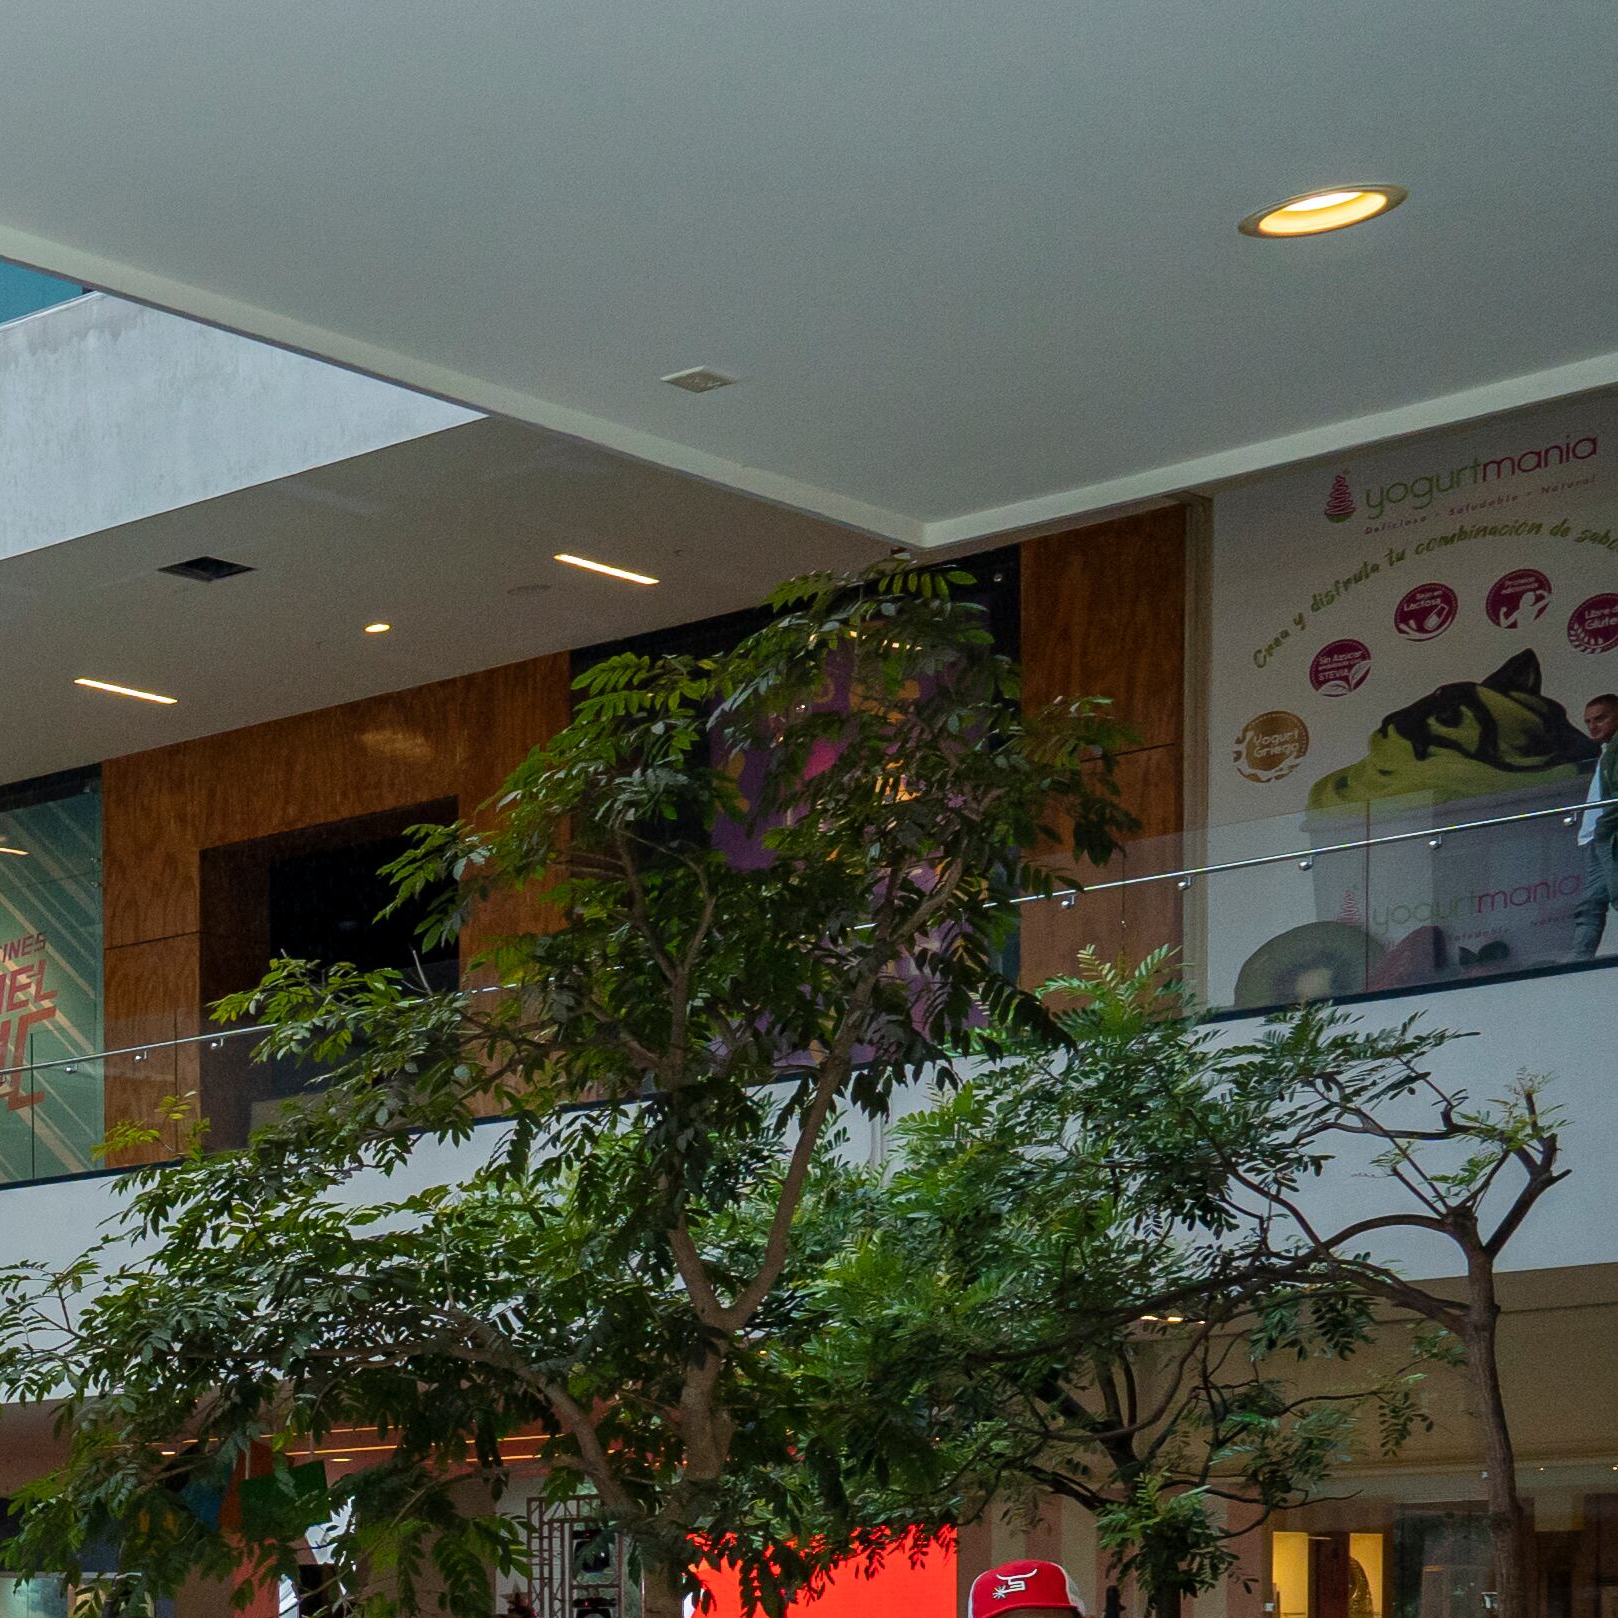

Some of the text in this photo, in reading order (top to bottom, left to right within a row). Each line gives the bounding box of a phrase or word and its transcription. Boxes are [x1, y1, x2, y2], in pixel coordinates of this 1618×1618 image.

[1365, 434, 1598, 519] yogurtmania
[1384, 548, 1406, 567] tu
[1549, 518, 1571, 538] de
